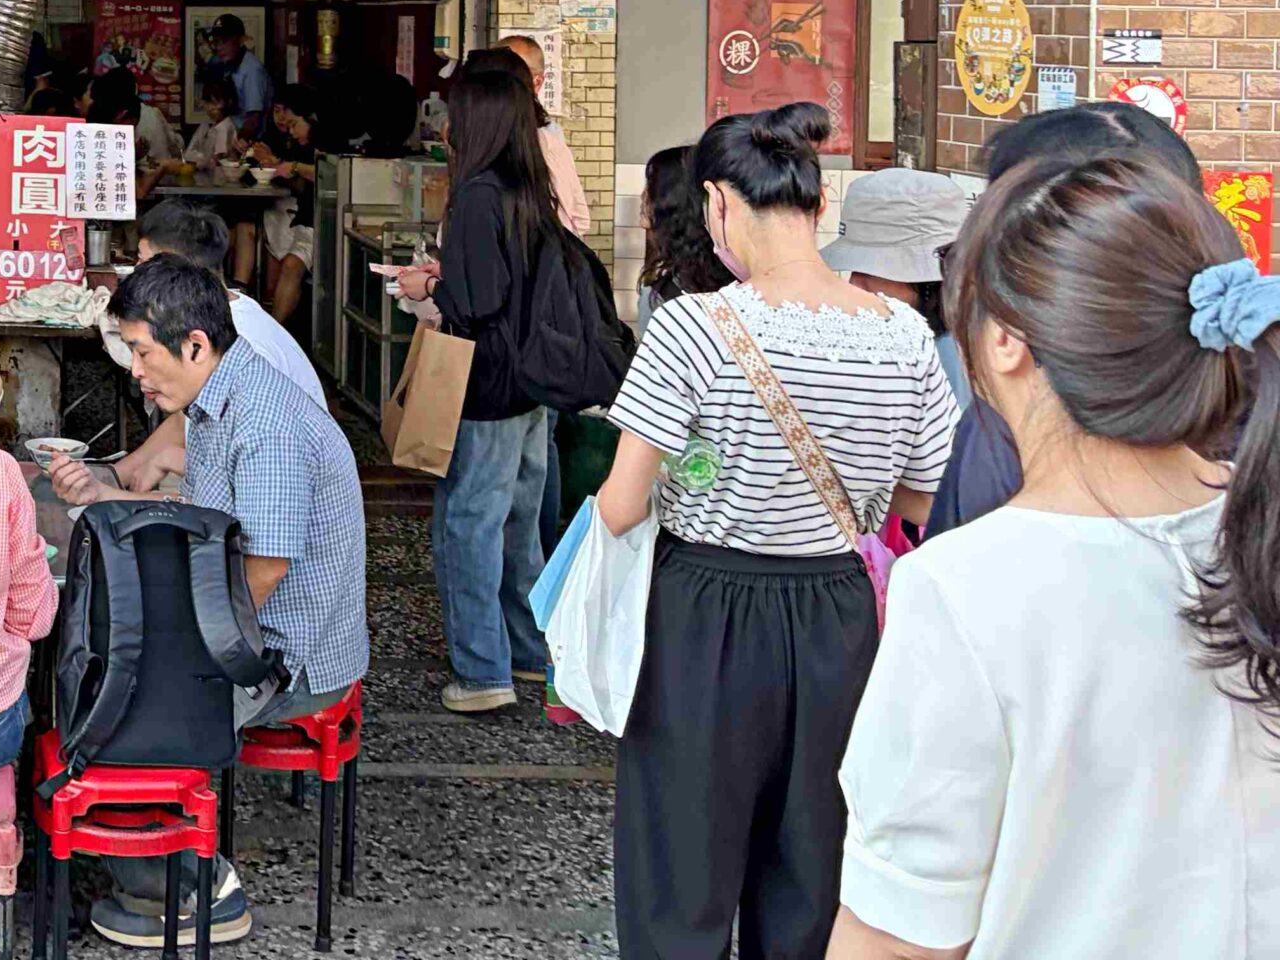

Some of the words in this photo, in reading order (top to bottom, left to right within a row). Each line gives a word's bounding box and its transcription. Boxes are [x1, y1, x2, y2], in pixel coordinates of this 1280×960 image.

[726, 39, 754, 67] 粿
[11, 124, 66, 217] 肉圓
[6, 219, 28, 238] 小
